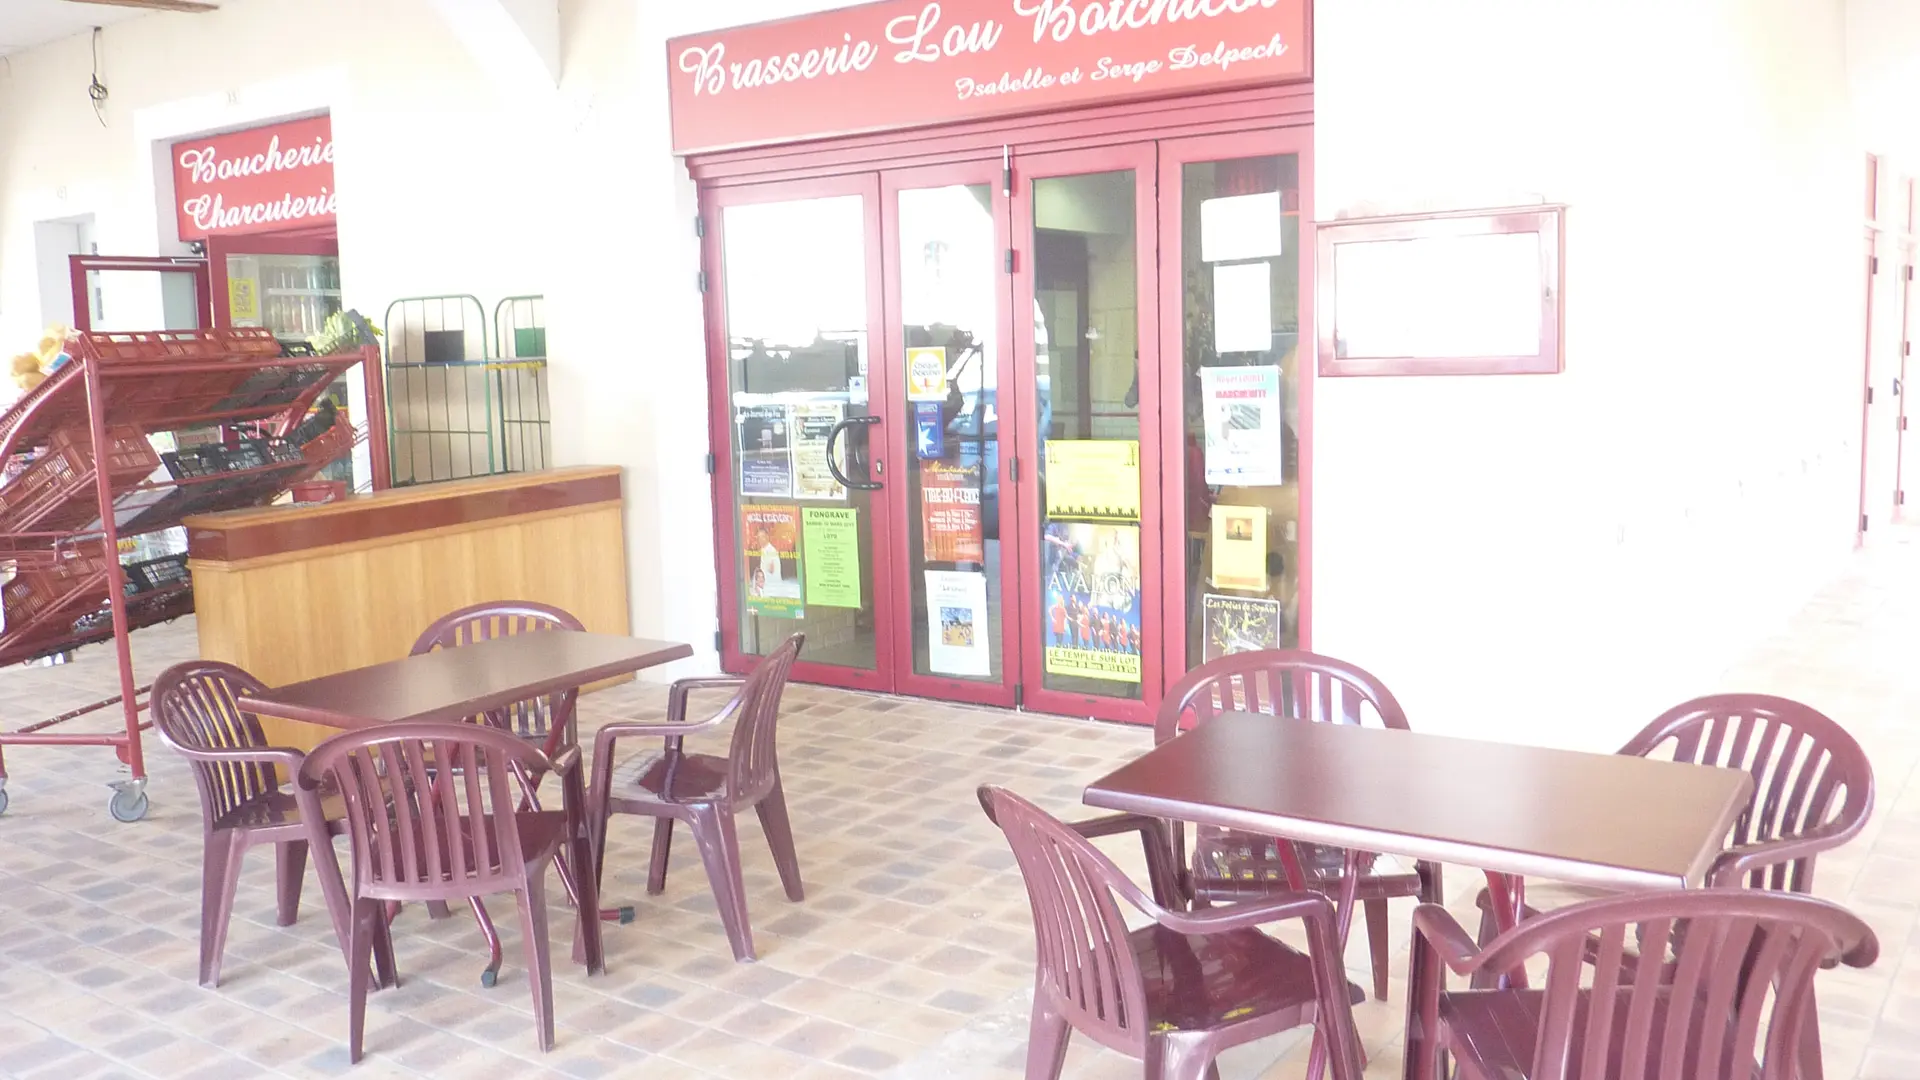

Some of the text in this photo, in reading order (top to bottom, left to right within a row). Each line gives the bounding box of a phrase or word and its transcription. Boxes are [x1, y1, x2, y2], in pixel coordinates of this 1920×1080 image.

[679, 32, 878, 96] Brasserie
[885, 2, 1003, 63] Lou
[954, 33, 1289, 99] Isabelle et Serge Delpech
[180, 134, 334, 184] Boucherie
[183, 186, 338, 230] Charcuterie
[809, 511, 849, 519] FONGRAVE
[1048, 571, 1136, 597] AVALON
[1049, 648, 1137, 666] LE TEMPLE SUR LOT
